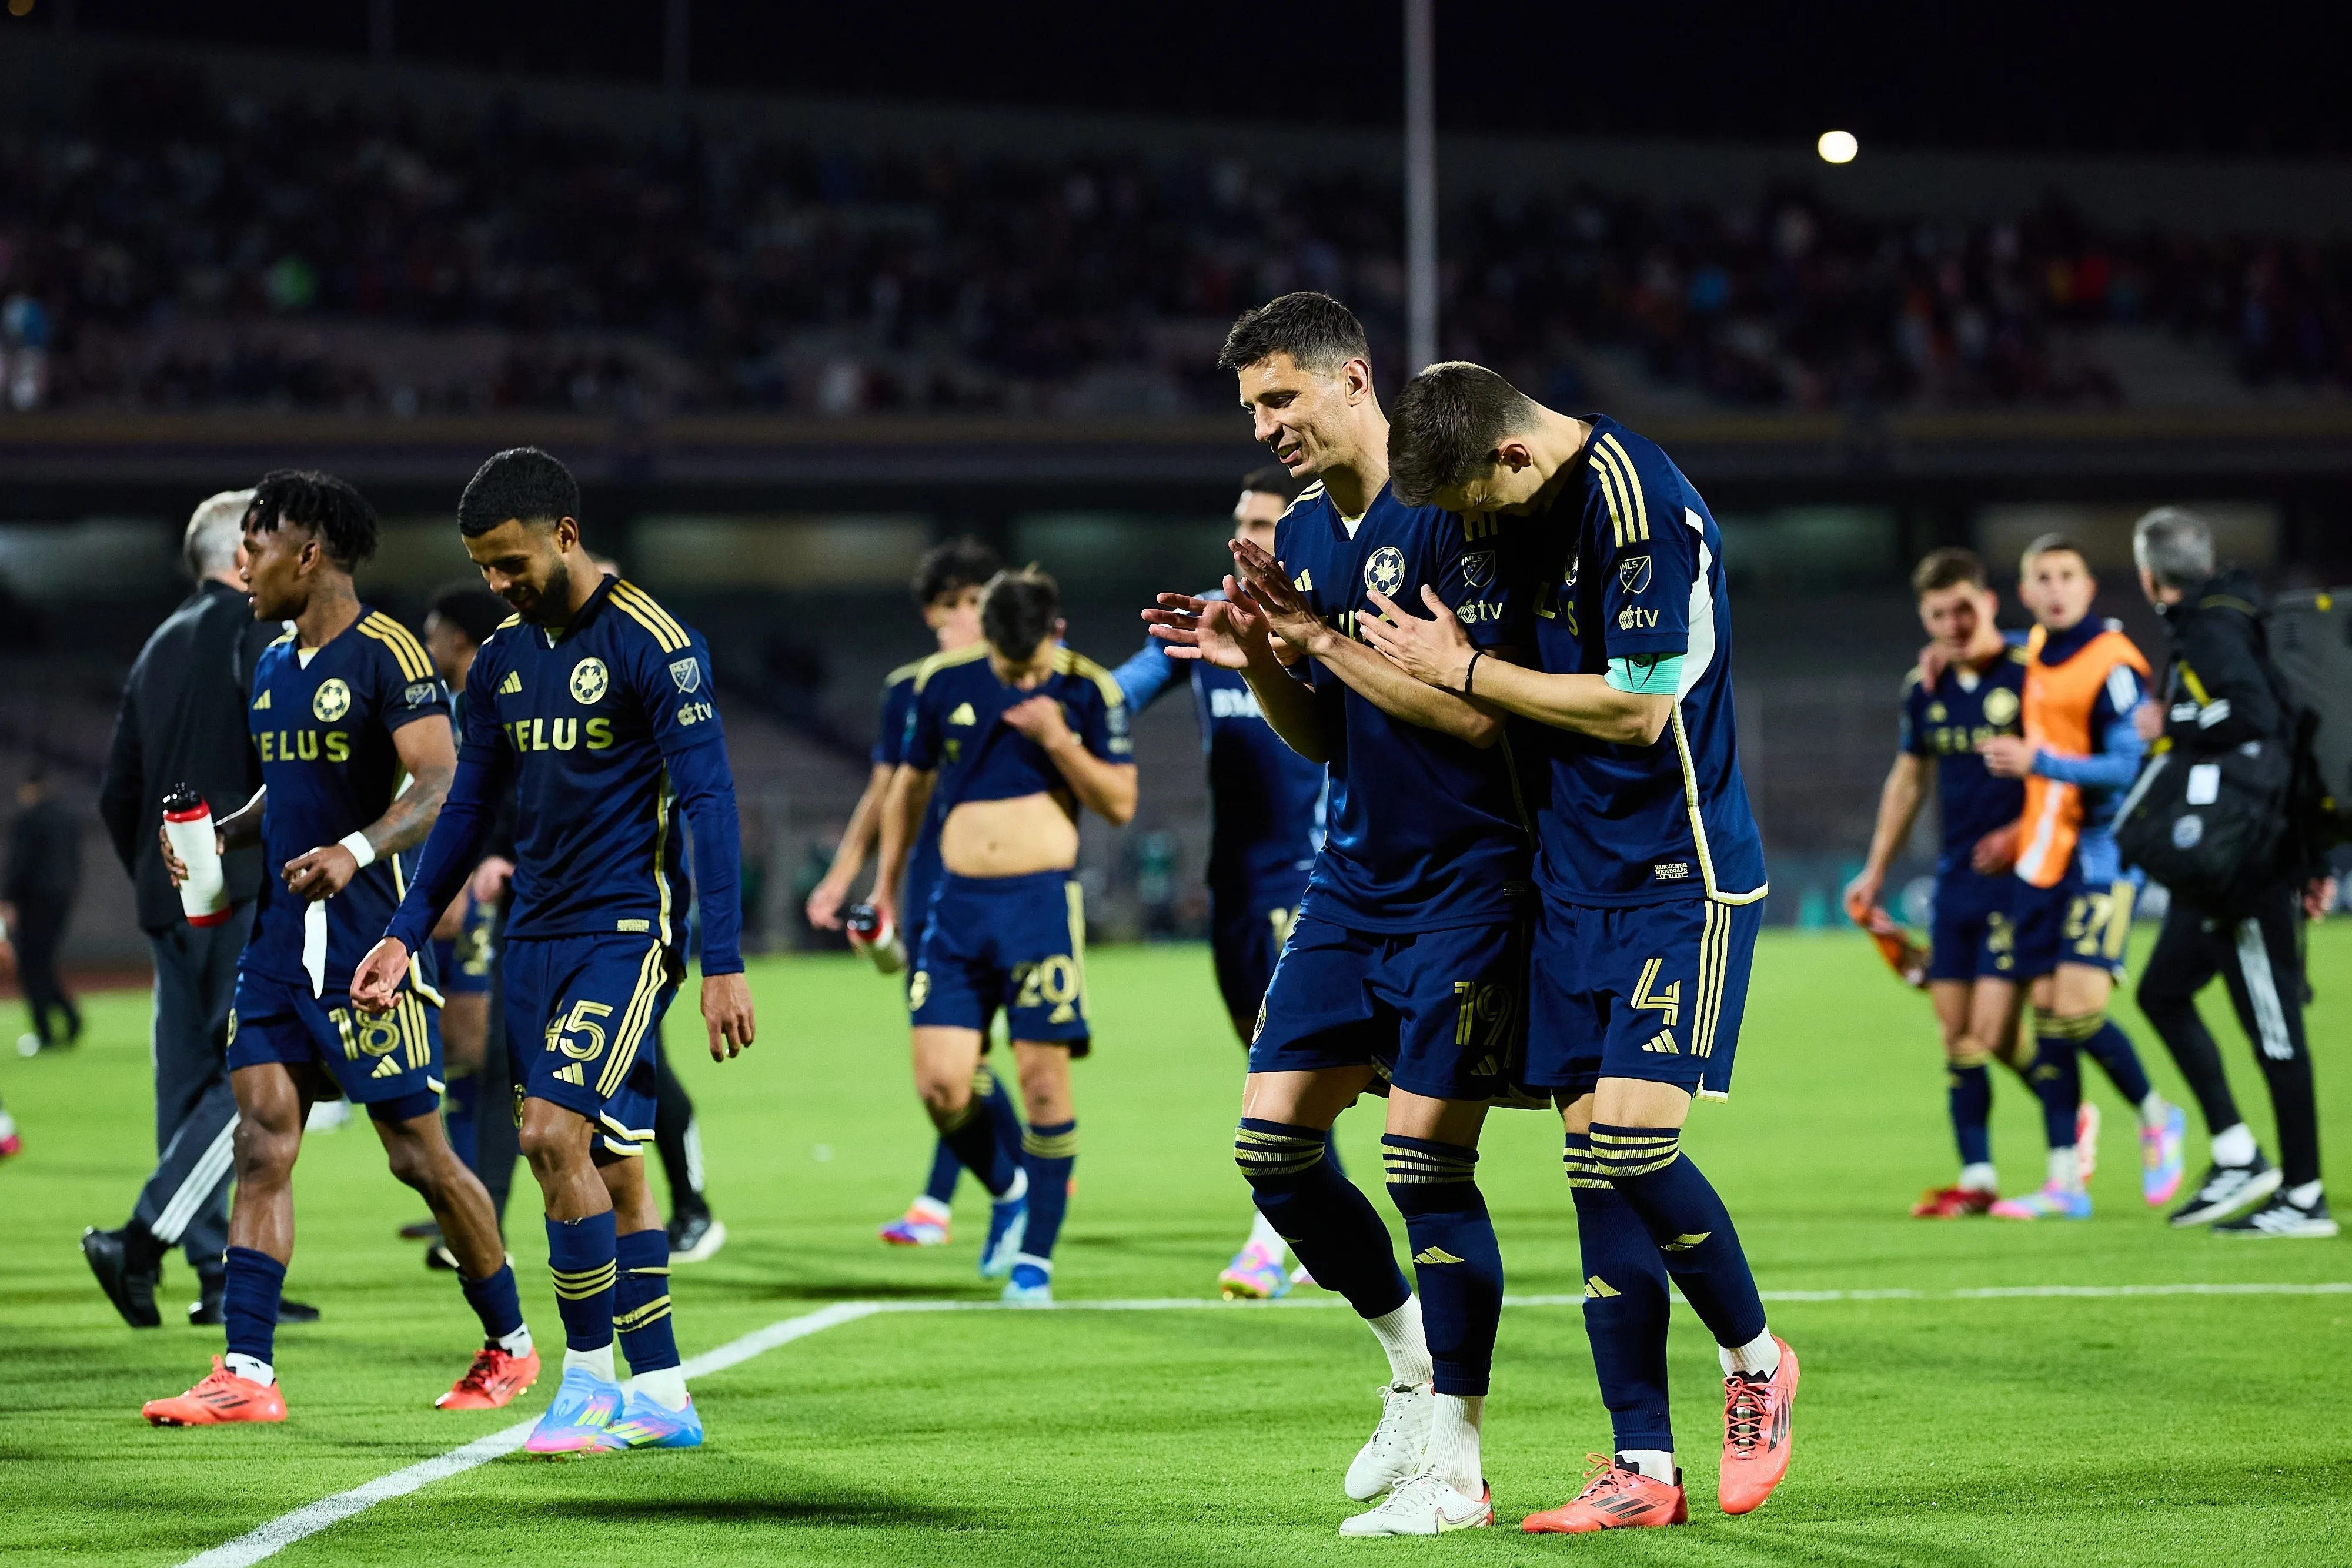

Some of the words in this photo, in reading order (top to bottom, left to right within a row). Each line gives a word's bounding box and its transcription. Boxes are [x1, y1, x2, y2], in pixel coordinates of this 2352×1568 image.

[1464, 554, 1482, 564] MLS
[1621, 560, 1638, 570] MLS
[1477, 600, 1503, 621] tv
[1635, 606, 1659, 628] tv
[694, 701, 713, 721] tv
[1211, 688, 1263, 718] BM
[251, 730, 351, 763] ELUS
[1011, 954, 1078, 1007] 20
[1631, 958, 1681, 1025] 4
[1454, 981, 1513, 1047] 19
[328, 1007, 400, 1061] 18
[544, 999, 613, 1062] 45
